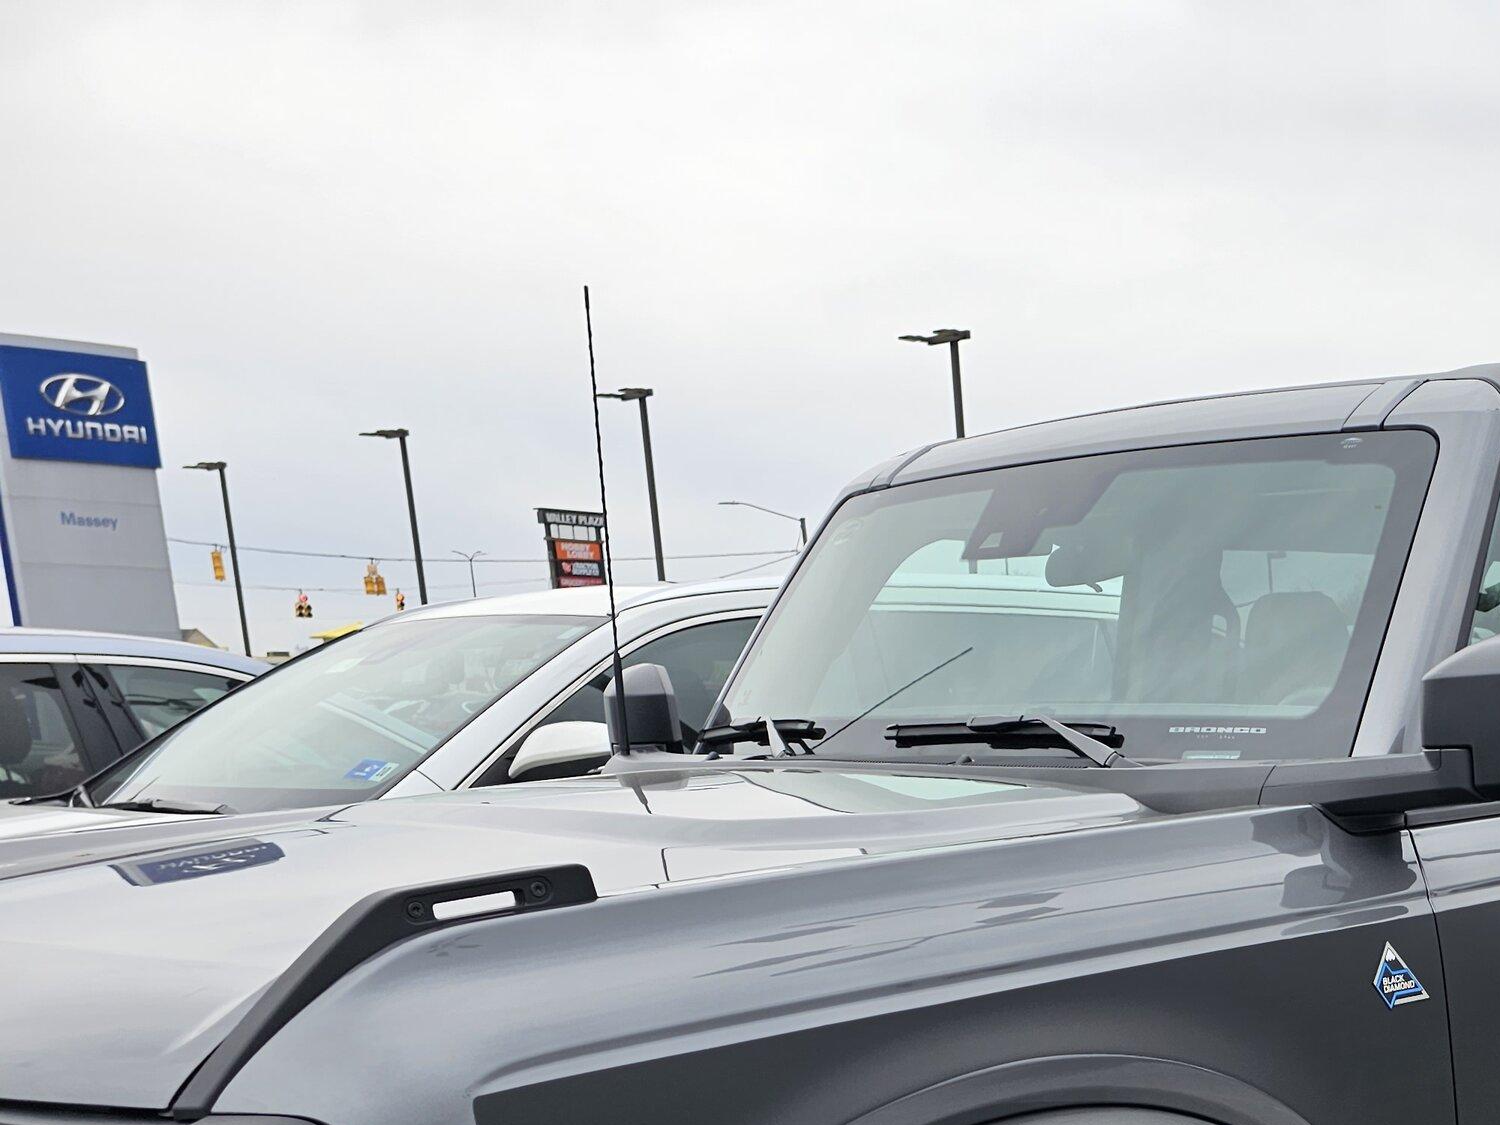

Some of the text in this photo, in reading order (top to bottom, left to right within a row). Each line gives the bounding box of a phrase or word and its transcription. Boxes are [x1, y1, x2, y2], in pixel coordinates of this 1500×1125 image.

[26, 416, 148, 444] HYUNDAI
[60, 511, 118, 531] Massey
[545, 512, 577, 524] VALLEY
[1168, 726, 1267, 734] BRONCO
[1382, 974, 1405, 986] BLACK
[1383, 979, 1415, 993] DIAMOND
